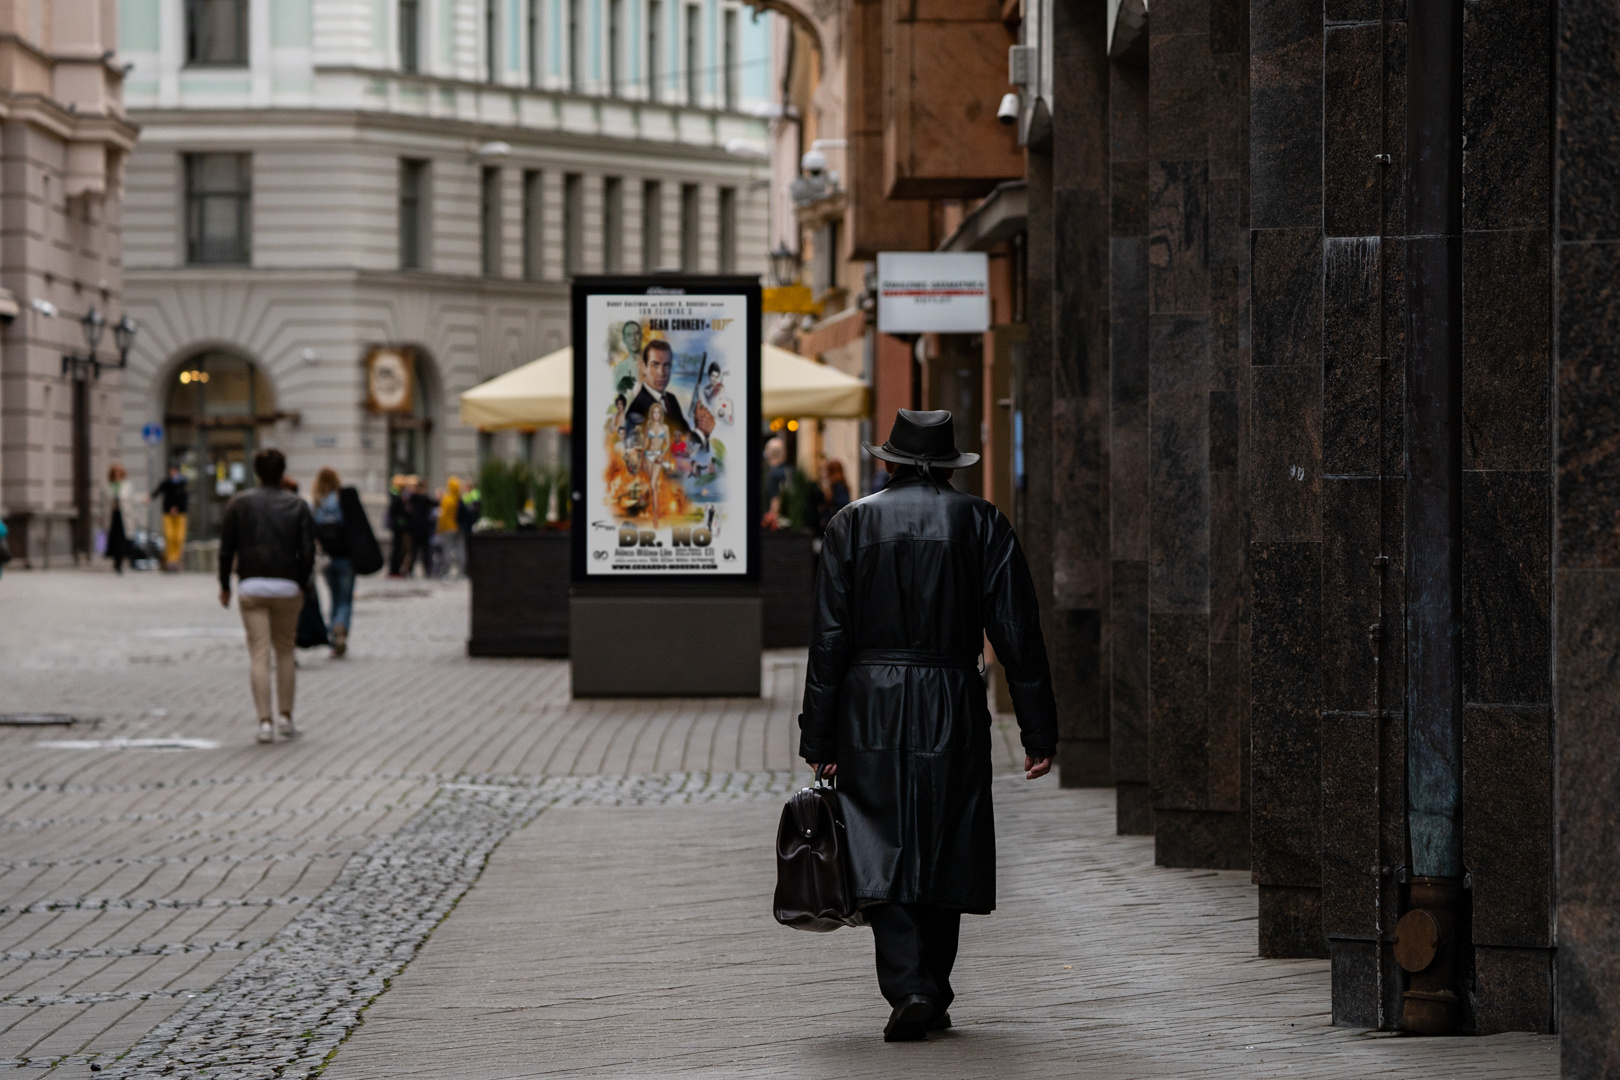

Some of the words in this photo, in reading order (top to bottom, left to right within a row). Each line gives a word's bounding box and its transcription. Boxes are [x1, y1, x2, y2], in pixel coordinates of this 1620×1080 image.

[649, 319, 669, 331] SEAN
[672, 319, 706, 331] CONNERY
[711, 319, 729, 331] 007
[619, 528, 663, 547] DR.
[672, 528, 712, 547] NO
